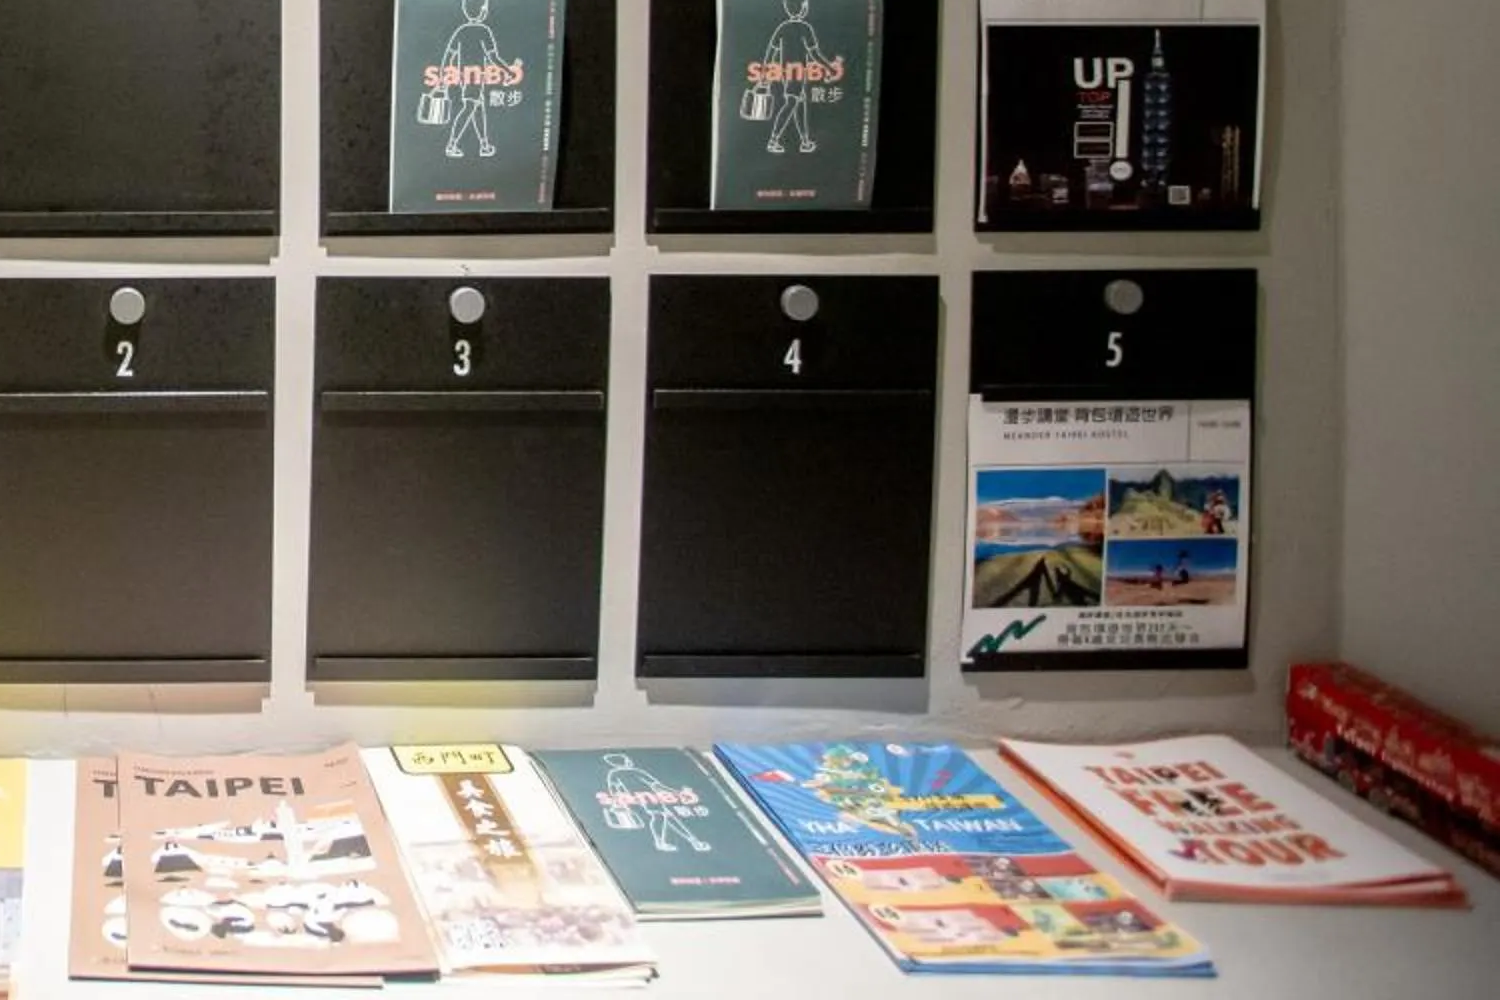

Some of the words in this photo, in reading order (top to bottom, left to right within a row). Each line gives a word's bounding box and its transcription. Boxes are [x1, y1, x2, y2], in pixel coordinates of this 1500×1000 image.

[1073, 57, 1135, 89] UP
[115, 340, 134, 377] 2
[453, 339, 471, 377] 3
[783, 338, 802, 374] 4
[1105, 331, 1123, 368] 5
[134, 776, 305, 798] TAIPEI
[1083, 761, 1227, 786] TAIPEI
[1106, 782, 1277, 817] FREE
[914, 818, 1023, 832] TAIWAN
[1180, 833, 1348, 867] TOUR
